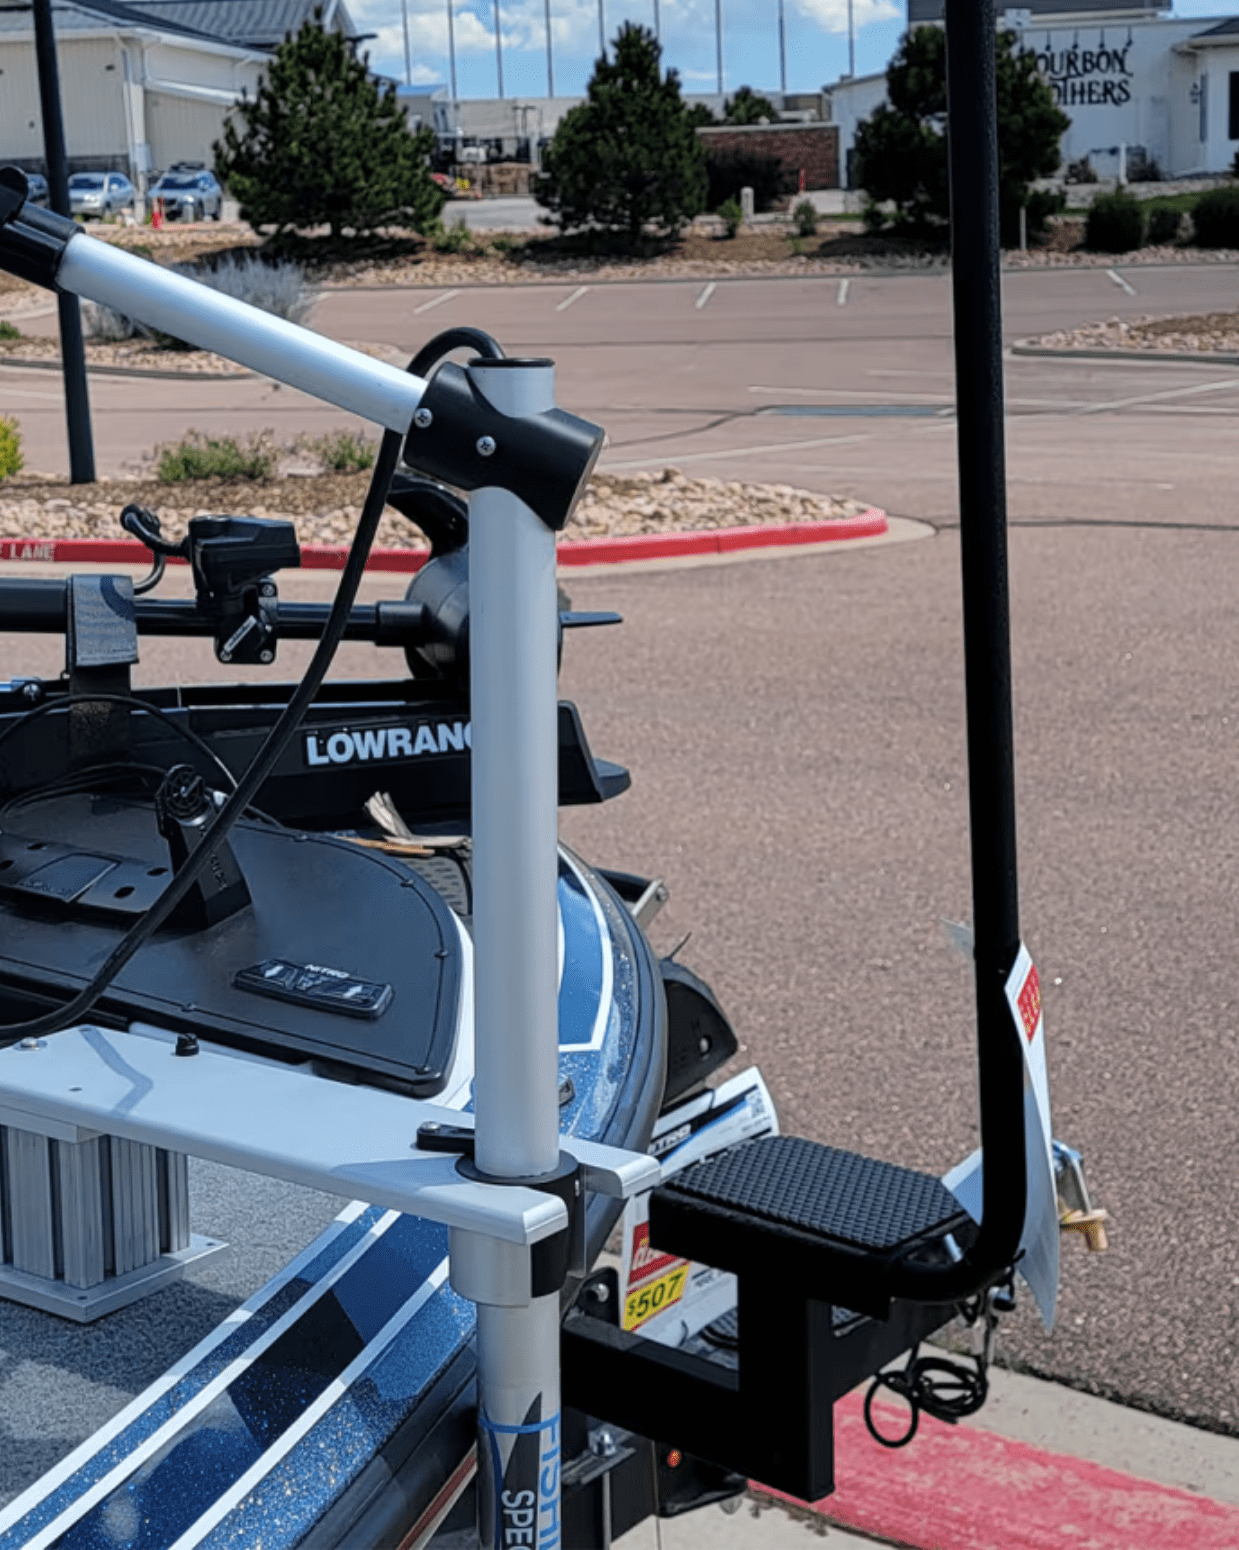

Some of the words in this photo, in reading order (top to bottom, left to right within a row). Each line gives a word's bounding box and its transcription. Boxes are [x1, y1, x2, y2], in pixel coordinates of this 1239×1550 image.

[1033, 48, 1134, 78] OURBON
[10, 542, 55, 561] LANE
[306, 721, 471, 766] LOWRAN
[627, 1272, 684, 1318] $507
[501, 1489, 535, 1550] SPE
